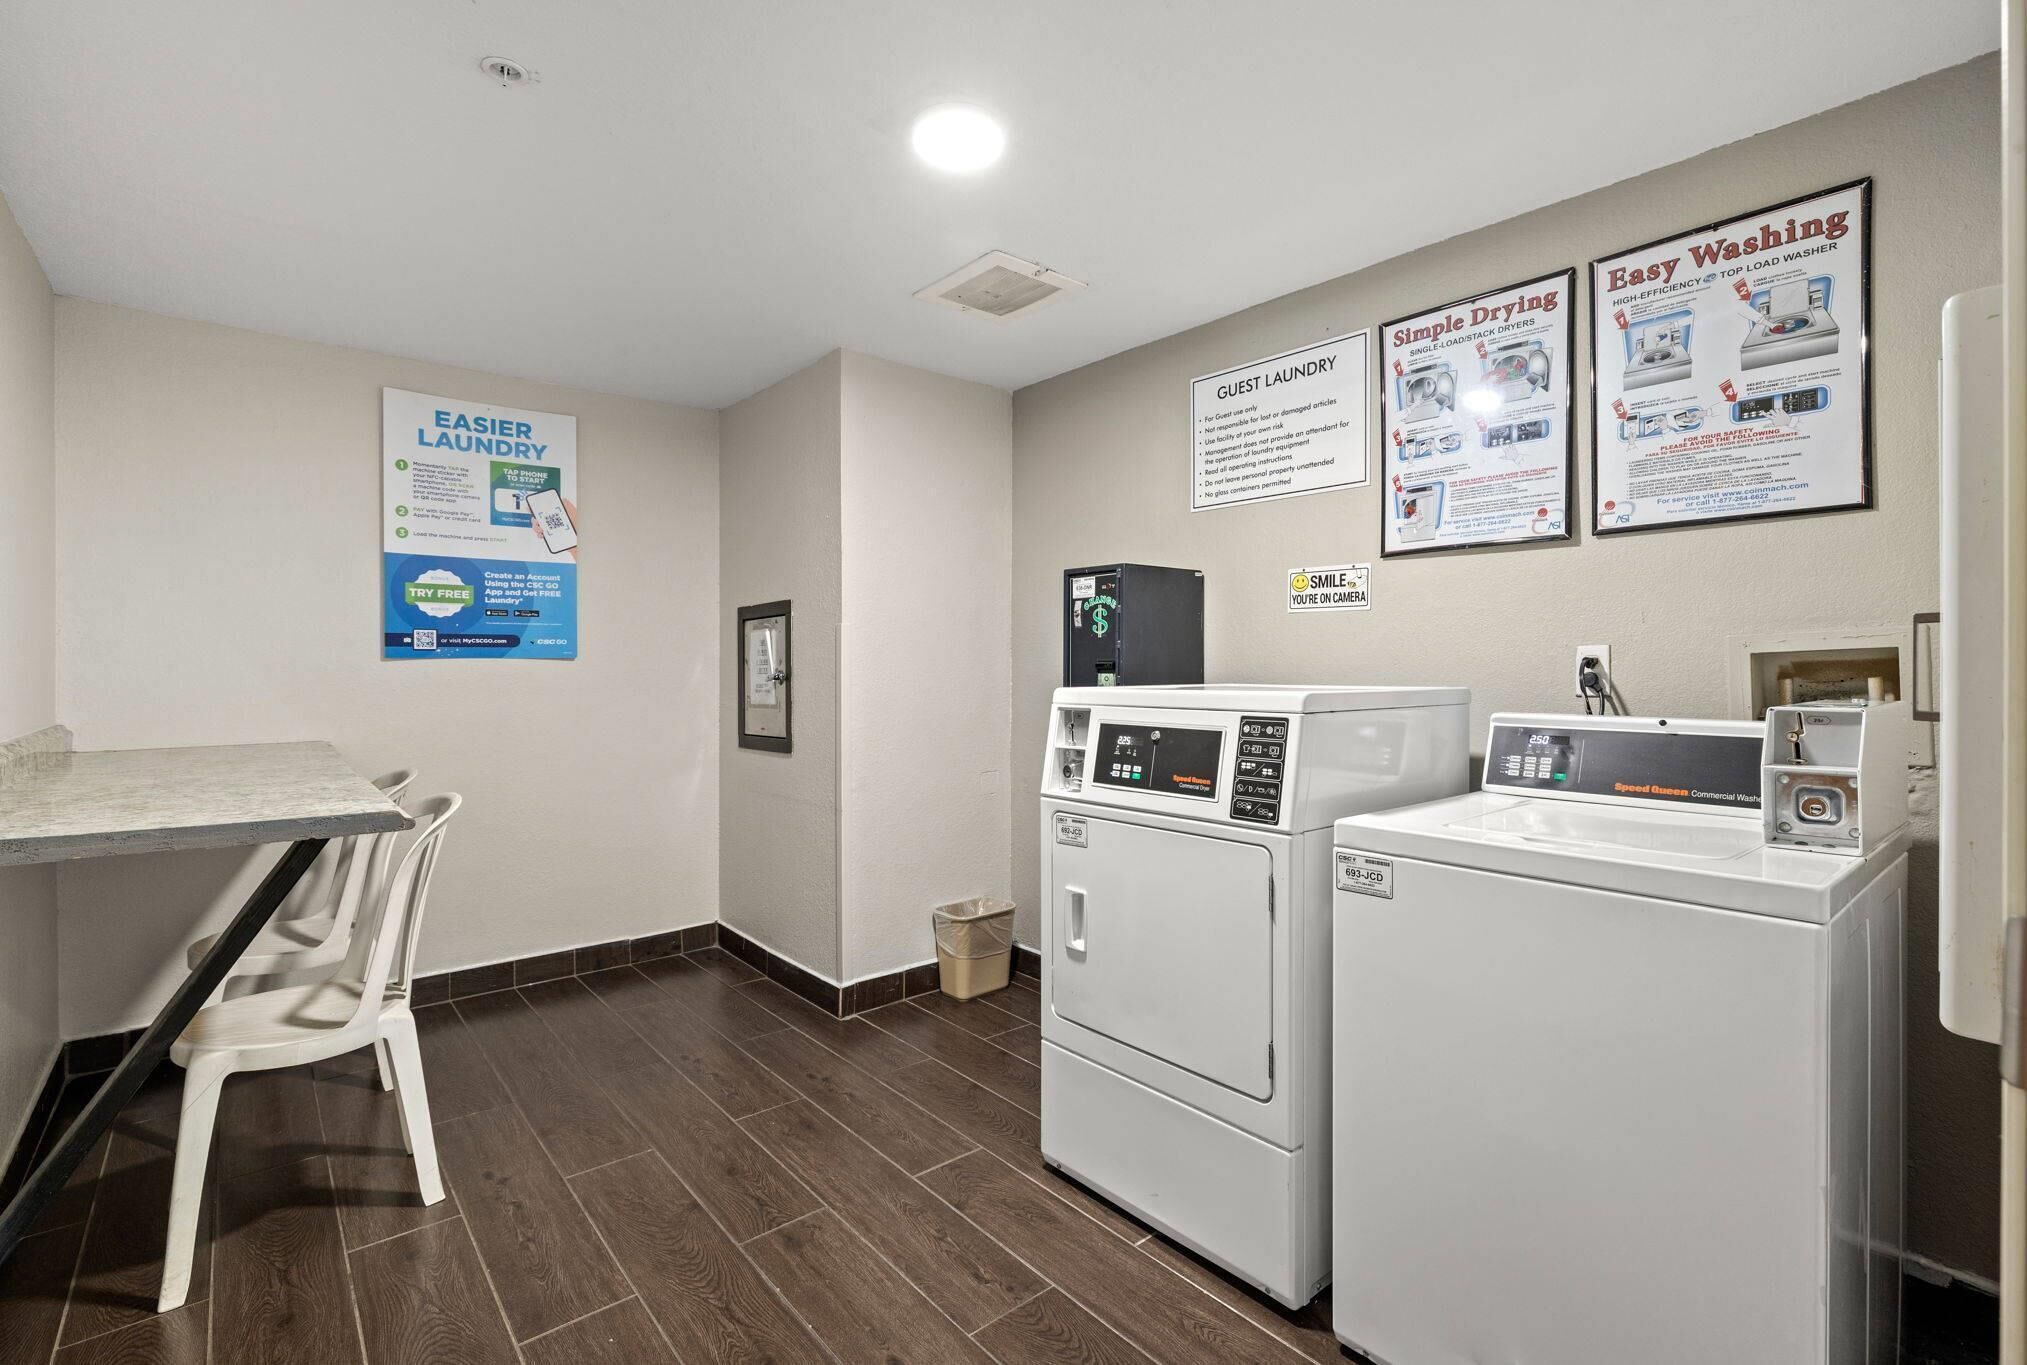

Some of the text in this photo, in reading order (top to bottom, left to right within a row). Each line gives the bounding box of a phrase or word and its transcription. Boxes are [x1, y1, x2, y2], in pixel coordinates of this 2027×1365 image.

[1608, 210, 1849, 292] Easy Washing
[1613, 277, 1701, 307] HIGH-EFFICIENCY
[1720, 267, 1744, 279] TOP
[1747, 257, 1780, 274] LOAD
[1783, 242, 1838, 262] WASHER
[1740, 286, 1748, 296] 2
[1393, 315, 1464, 347] Simple
[1470, 291, 1558, 327] Drying
[1410, 327, 1495, 357] SINGLE-LOAD/STACK
[1498, 318, 1535, 333] DRYERS
[1217, 355, 1337, 399] GUEST LAUNDRY
[435, 410, 532, 439] EASIER
[1205, 415, 1213, 423] For
[1216, 411, 1232, 420] Guest
[1245, 405, 1257, 413] only
[1205, 426, 1215, 434] Not
[1217, 418, 1248, 431] responsible
[1261, 413, 1271, 421] lost
[1281, 403, 1311, 417] damaged
[1313, 399, 1336, 409] articles
[1205, 443, 1241, 456] Management
[1244, 440, 1257, 448] does
[1259, 437, 1268, 445] not
[1271, 432, 1293, 444] provide
[1306, 423, 1337, 435] attendant
[1217, 433, 1234, 442] facility
[1244, 429, 1256, 438] your
[1273, 421, 1283, 430] risk
[1661, 443, 1688, 451] PLEASE
[1689, 438, 1714, 448] AVOID
[1732, 428, 1780, 442] FOLLOWING
[1700, 432, 1722, 441] YOUR
[1723, 427, 1754, 438] SAFETY
[418, 428, 547, 461] LAUNDRY
[1205, 438, 1309, 465] the operation of laundry equipment
[521, 470, 548, 478] PHONE
[1205, 466, 1218, 475] Read
[1229, 460, 1256, 472] operating
[1258, 454, 1292, 465] instructions
[1205, 479, 1213, 487] Do
[1215, 477, 1223, 485] not
[1242, 469, 1267, 482] personal
[1269, 466, 1295, 477] property
[1297, 457, 1334, 471] unattended
[1205, 477, 1291, 498] No glass containers permitted
[1722, 484, 1808, 497] www.coinmach.com
[485, 580, 509, 588] Using
[1310, 573, 1346, 589] SMILE
[409, 588, 470, 599] TRY FREE
[1084, 595, 1116, 610] CHANGE
[1292, 591, 1366, 605] YOU'RE ON CAMERA
[1092, 605, 1108, 638] $
[1615, 783, 1761, 802] Speed Queen Commercial Washe
[1346, 868, 1383, 881] 693-JCD
